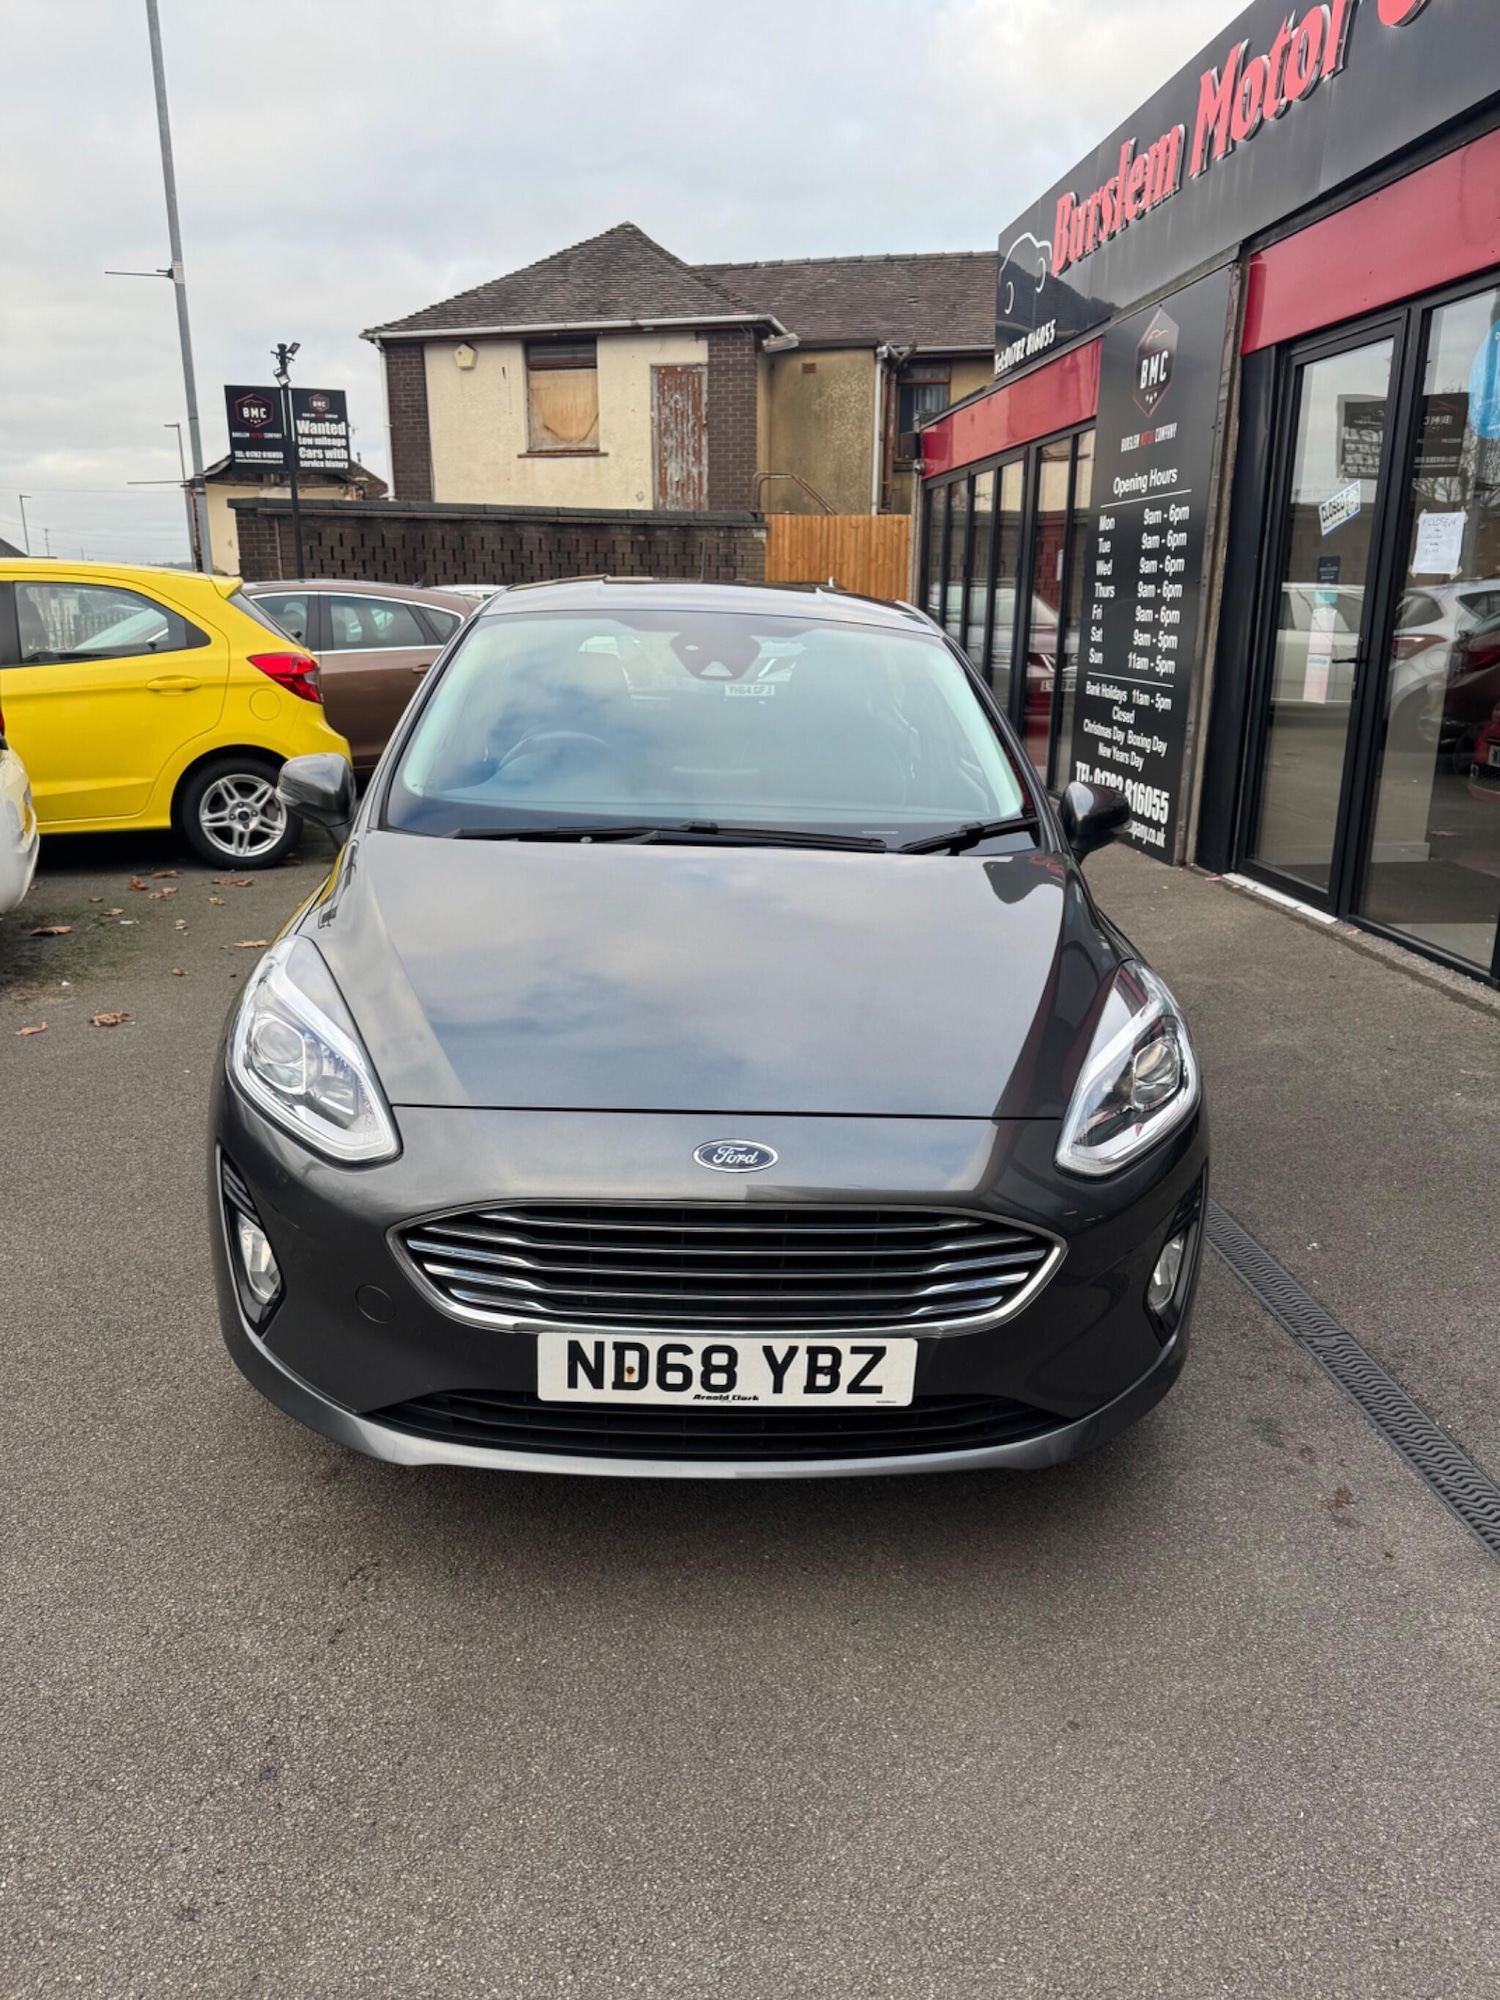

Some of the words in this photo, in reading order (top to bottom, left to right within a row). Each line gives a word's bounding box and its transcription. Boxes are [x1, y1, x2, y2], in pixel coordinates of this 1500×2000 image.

[1051, 123, 1186, 276] Burslem
[1189, 0, 1355, 178] Motor
[1140, 350, 1168, 389] BMC
[243, 407, 267, 418] BMC
[297, 420, 346, 435] Wanted
[298, 436, 313, 445] Low
[314, 437, 346, 447] mileage
[298, 446, 324, 459] Cars
[324, 448, 348, 459] with
[324, 460, 349, 469] history
[1113, 472, 1148, 497] Opening
[1150, 468, 1178, 487] Hours
[1099, 514, 1116, 531] Mon
[1143, 507, 1162, 525] 9am
[1169, 503, 1190, 526] 6pm
[1321, 493, 1345, 523] CLOSED
[1098, 537, 1111, 554] Tue
[1141, 532, 1160, 550] 9am
[1166, 529, 1187, 551] 6pm
[1096, 559, 1113, 576] Wed
[1139, 556, 1158, 574] 9am
[1164, 555, 1185, 577] 6pm
[1094, 582, 1115, 598] Thurs
[1137, 580, 1156, 598] 9am
[1162, 580, 1183, 602] 6pm
[1092, 604, 1103, 620] Fri
[1135, 605, 1153, 622] 9am
[1160, 605, 1180, 627] 6pm
[1090, 626, 1103, 642] Sat
[1133, 628, 1151, 647] 9am
[1157, 630, 1178, 652] 5pm
[1088, 647, 1103, 664] Sun
[1127, 651, 1149, 671] 11am
[1155, 654, 1176, 677] 5pm
[1085, 681, 1101, 696] Bank
[1101, 683, 1128, 704] Holidays
[1132, 689, 1150, 706] 11am
[1155, 692, 1172, 712] 5pm
[1112, 706, 1135, 724] Closed
[1083, 718, 1112, 739] Christmas
[1112, 725, 1126, 745] Day
[1127, 730, 1152, 753] Boxing
[1152, 736, 1168, 757] Day
[1098, 741, 1112, 758] New
[1112, 745, 1130, 764] Years
[1130, 751, 1144, 772] Day
[1124, 778, 1170, 825] 816055
[712, 1146, 759, 1164] Ford
[566, 1340, 739, 1394] ND68
[762, 1345, 887, 1395] YBZ
